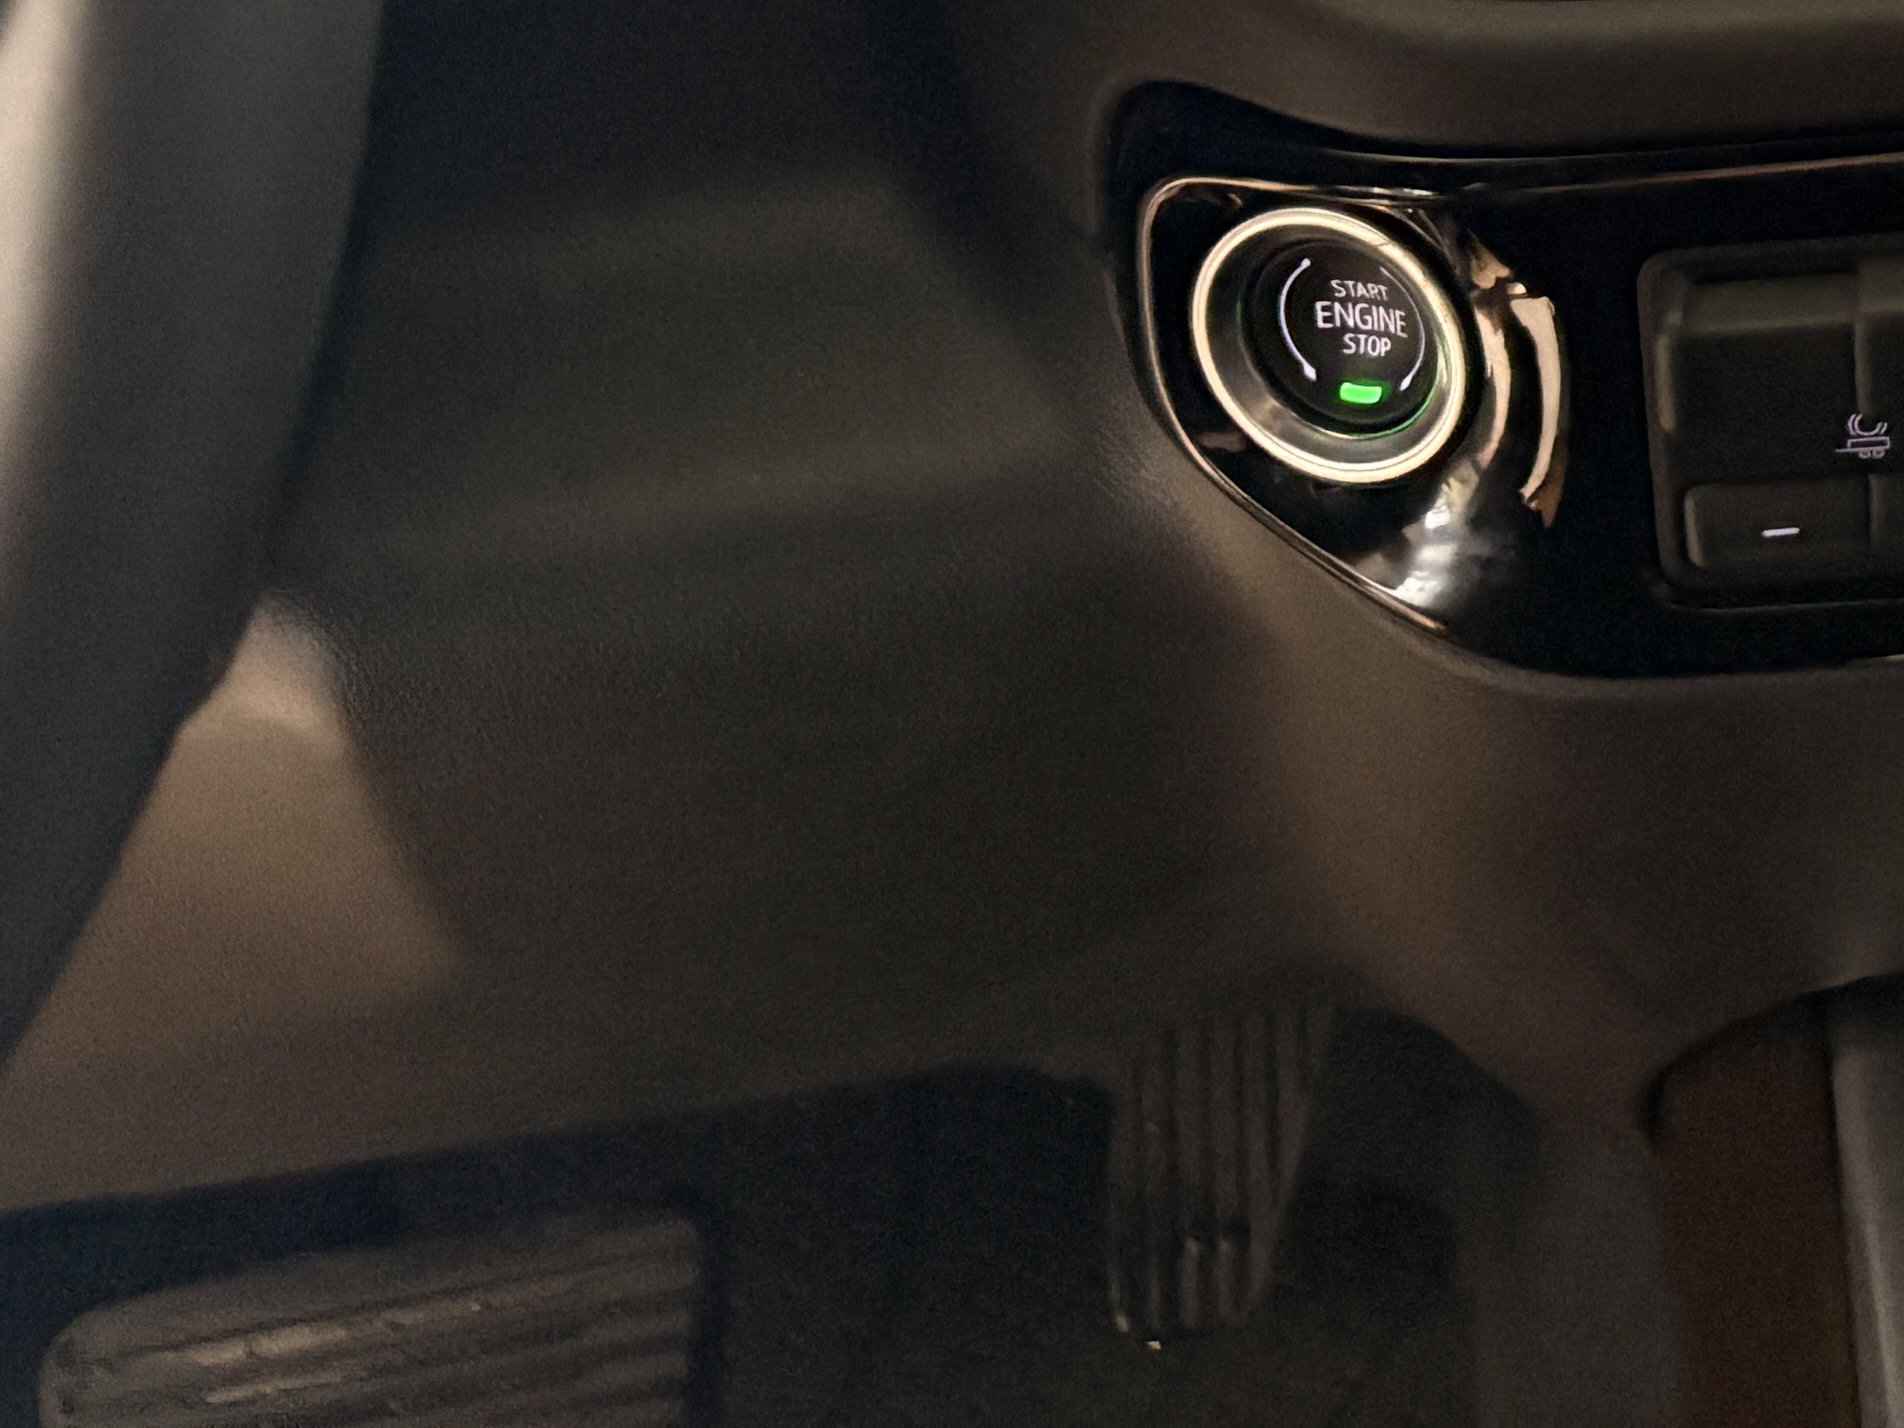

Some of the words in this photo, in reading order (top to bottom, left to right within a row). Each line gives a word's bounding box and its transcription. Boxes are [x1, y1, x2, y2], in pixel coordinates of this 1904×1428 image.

[1330, 279, 1388, 301] START
[1315, 300, 1407, 339] ENGINE
[1343, 331, 1392, 357] STOP
